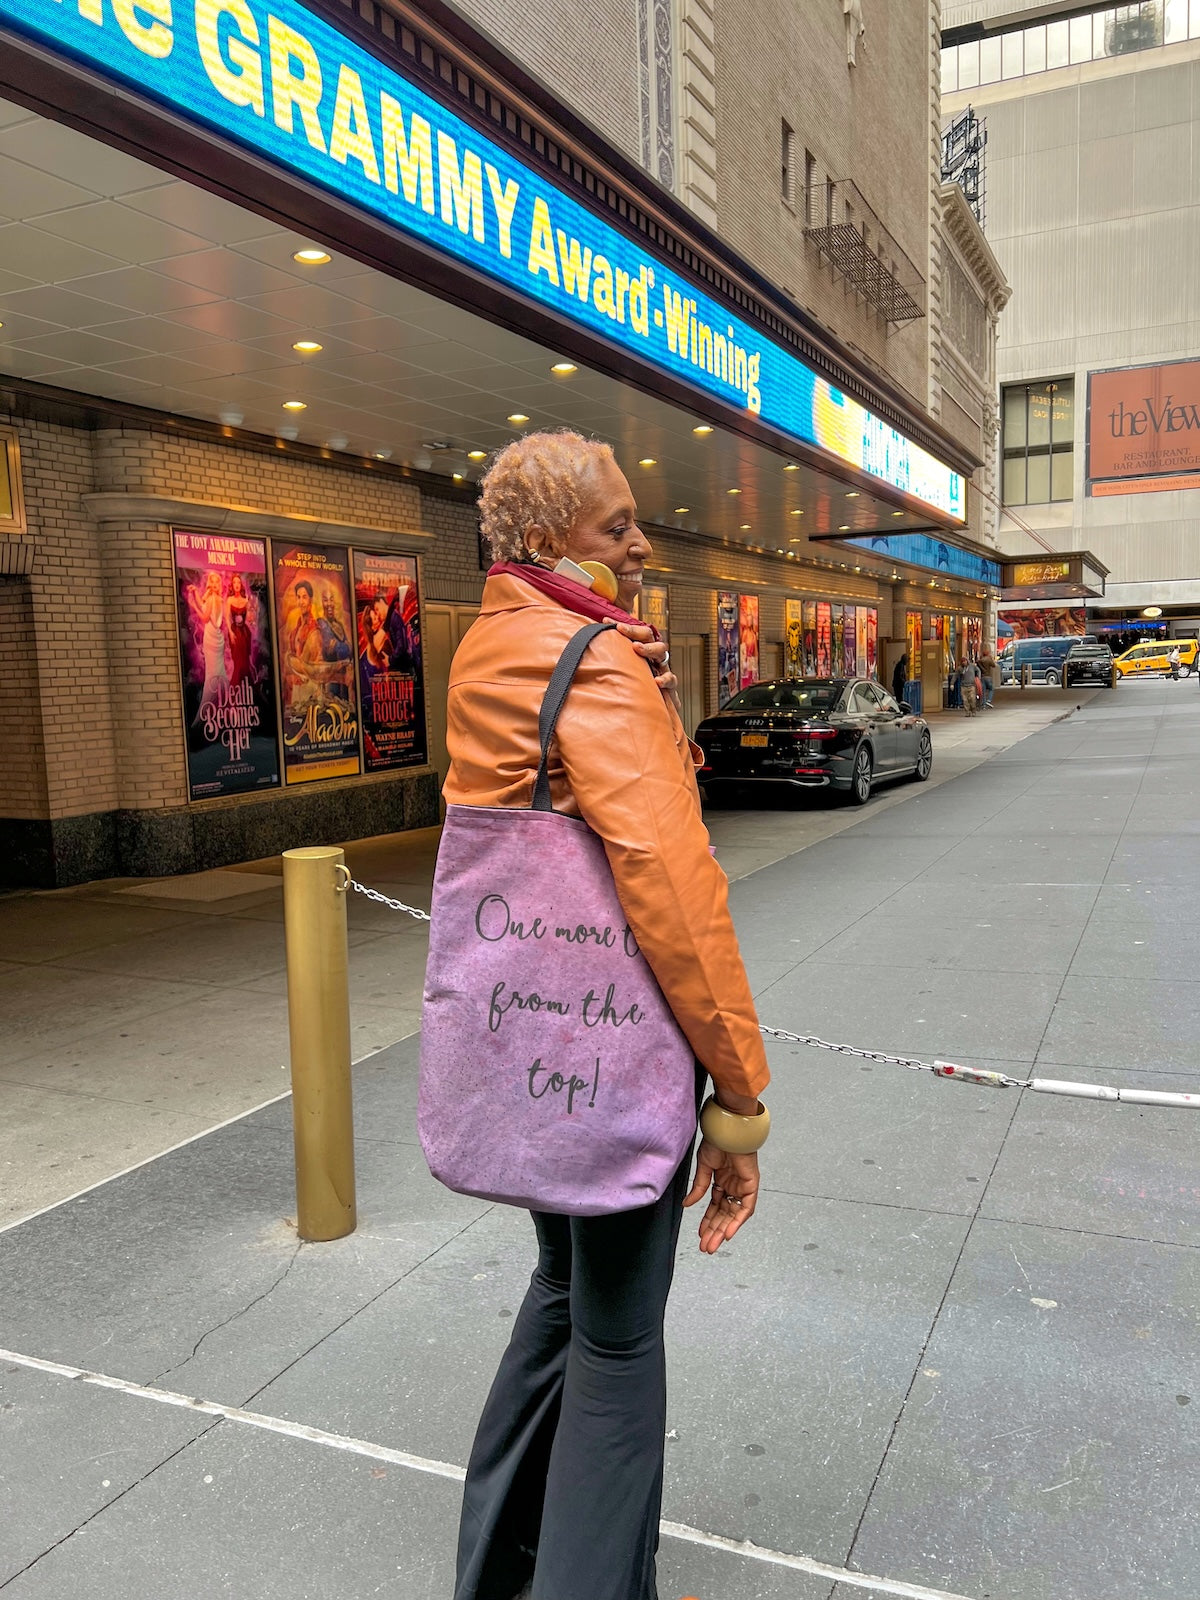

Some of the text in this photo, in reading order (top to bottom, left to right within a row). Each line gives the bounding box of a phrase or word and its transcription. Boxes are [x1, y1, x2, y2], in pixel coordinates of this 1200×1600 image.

[194, 0, 520, 259] GRAMMY
[1113, 462, 1133, 471] BAR
[1136, 459, 1158, 470] AND
[175, 534, 189, 549] THE
[207, 551, 236, 566] MUSICAL
[296, 552, 327, 563] STEP INTO
[278, 558, 284, 566] A
[283, 559, 307, 568] WHOLE
[307, 560, 322, 569] NEW
[209, 675, 255, 709] Death
[200, 701, 261, 743] Becomes
[284, 703, 358, 747] Aladdin
[221, 727, 252, 762] Her
[475, 894, 547, 942] One
[555, 925, 616, 948] more
[489, 982, 645, 1033] from the
[527, 1057, 600, 1114] top!
